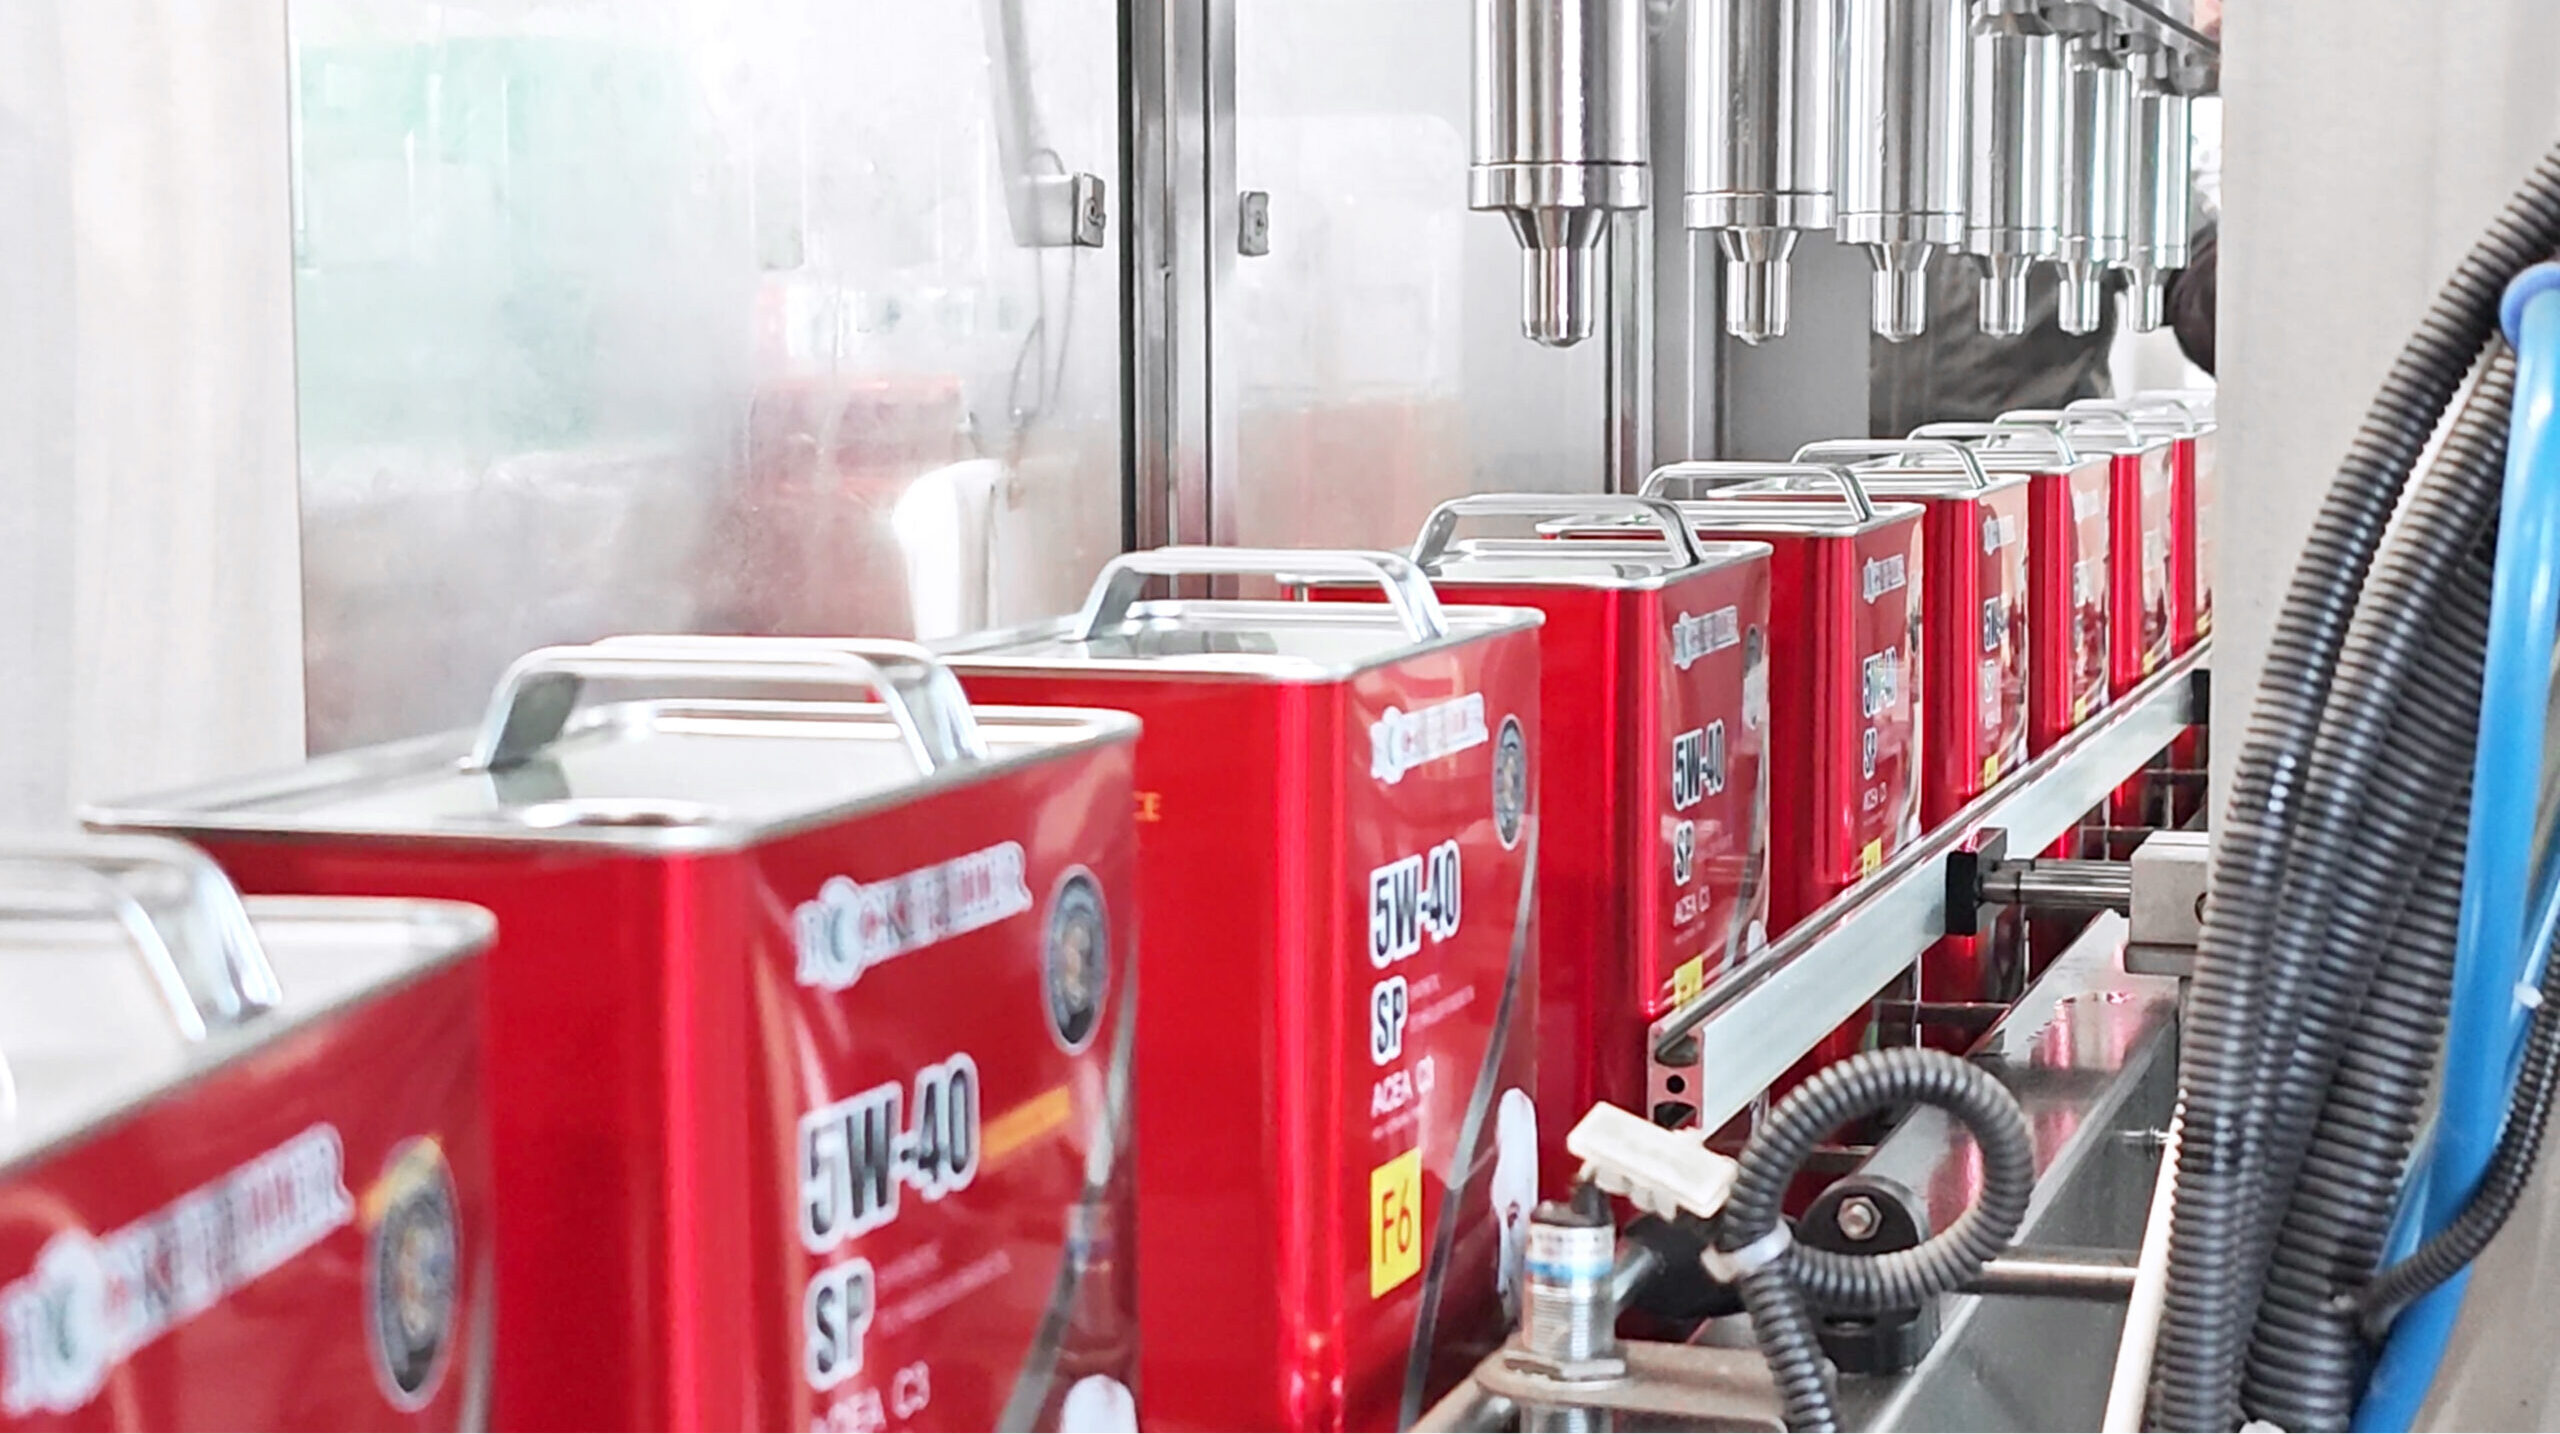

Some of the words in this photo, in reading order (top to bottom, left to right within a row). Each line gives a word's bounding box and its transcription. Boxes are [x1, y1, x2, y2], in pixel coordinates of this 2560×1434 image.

[1674, 719, 1724, 811] 5W-40
[1674, 820, 1694, 886] SP
[1371, 840, 1461, 968] 5W-40
[1371, 976, 1408, 1065] SP
[800, 1053, 979, 1253] 5W-40
[1382, 1179, 1412, 1264] F6
[803, 1257, 875, 1390] SP
